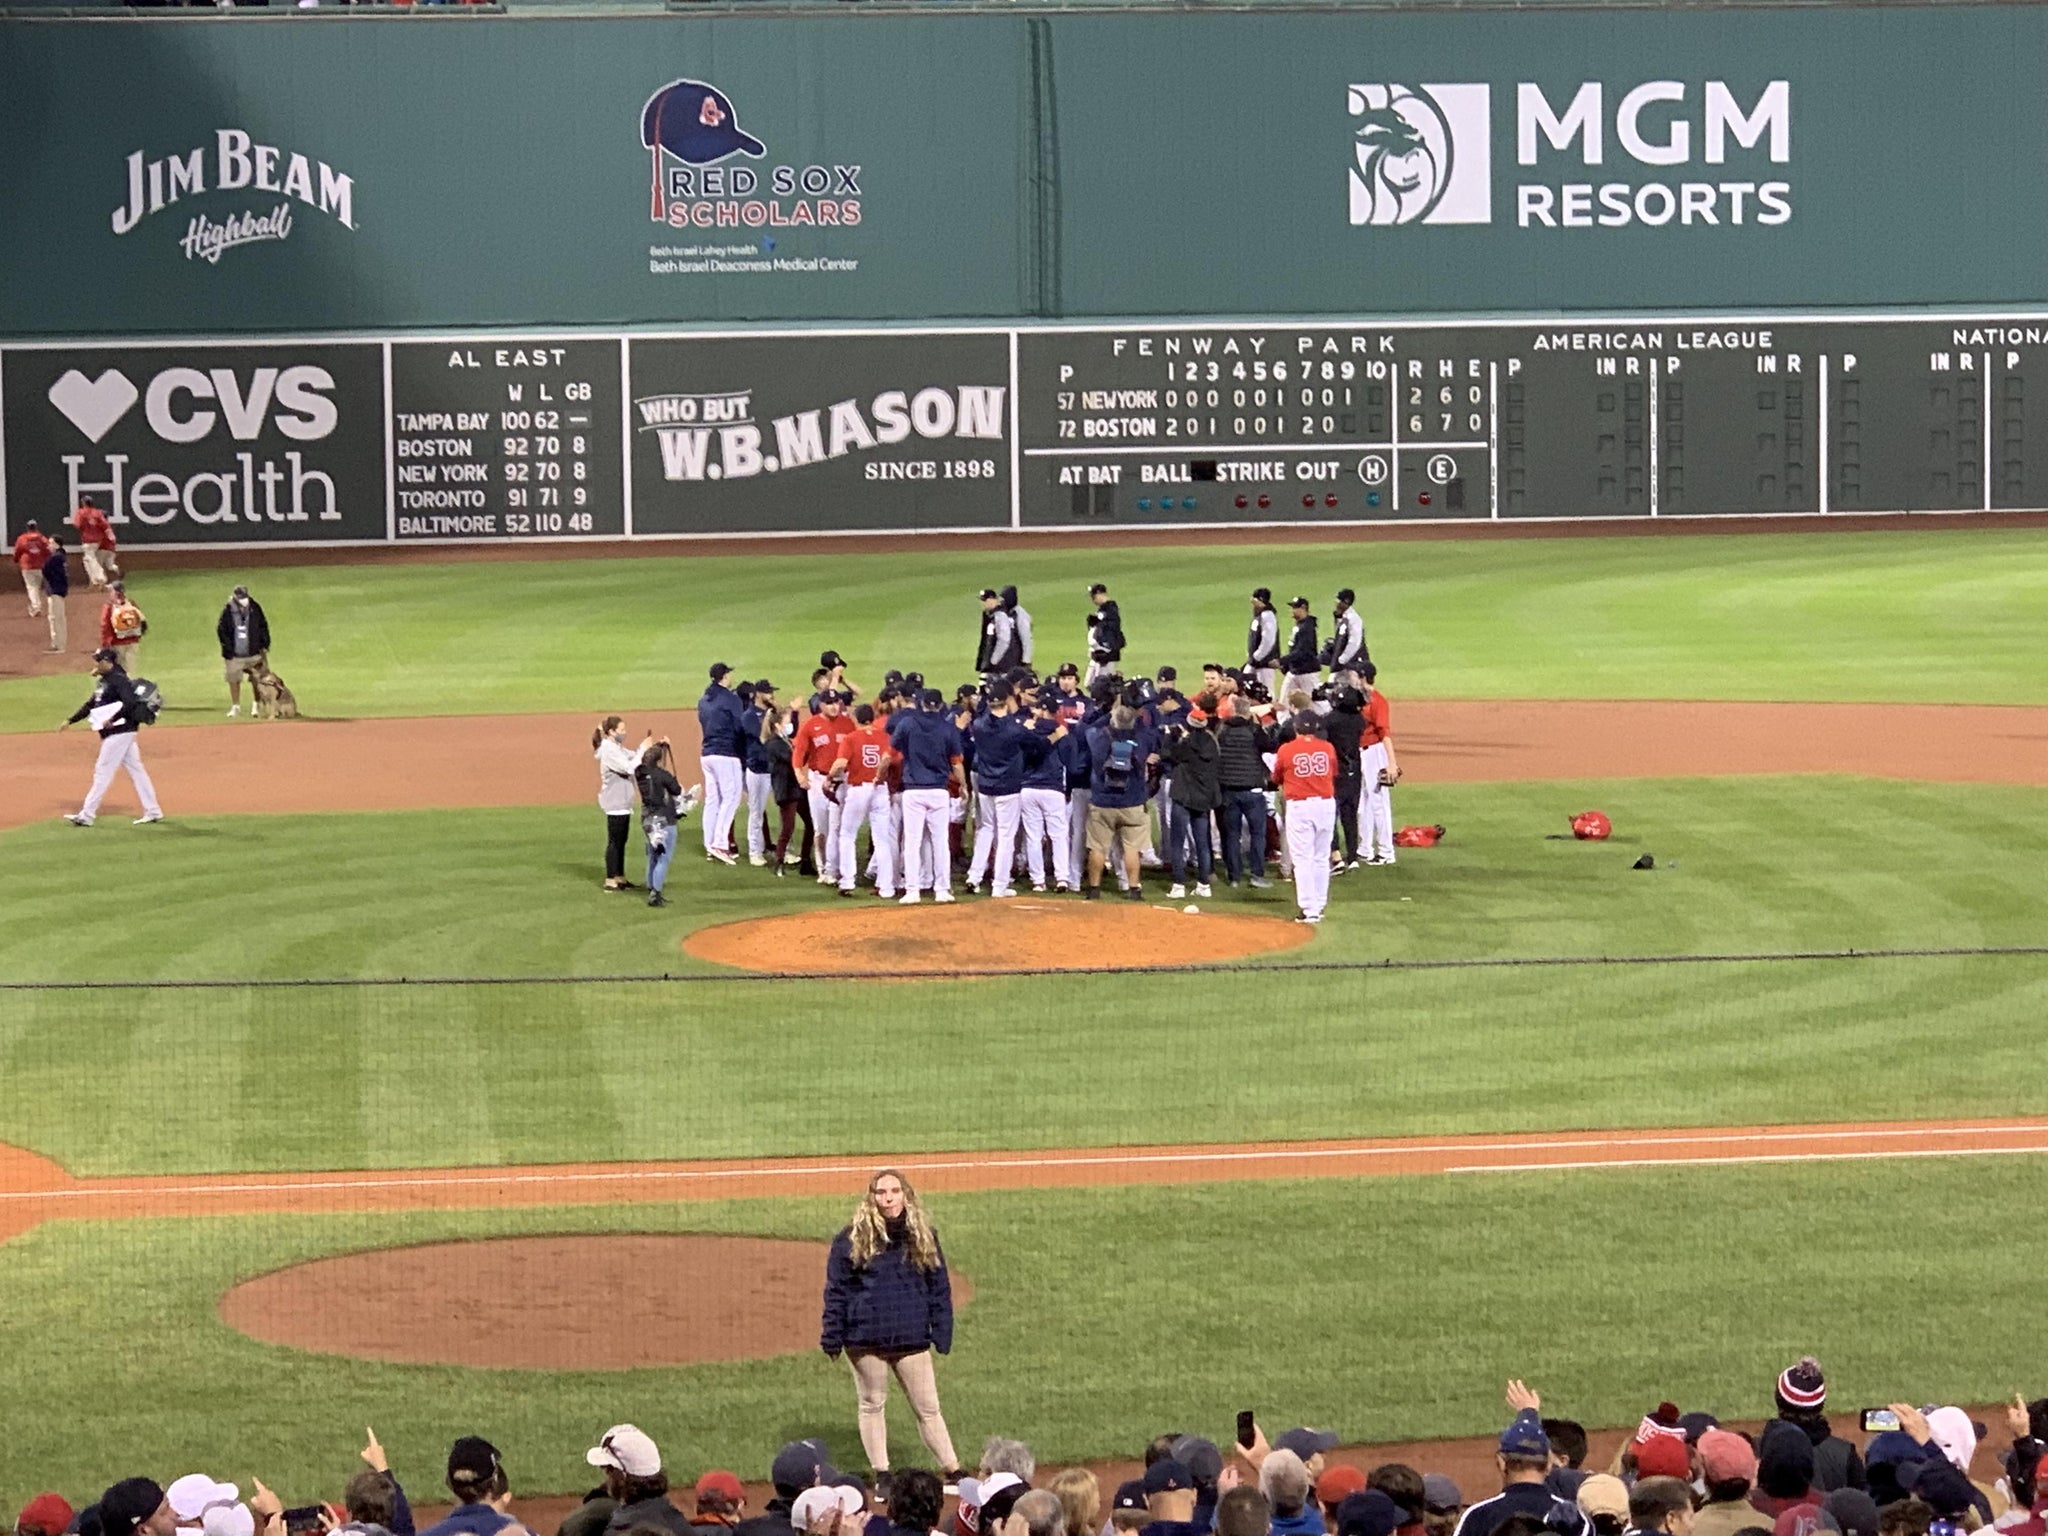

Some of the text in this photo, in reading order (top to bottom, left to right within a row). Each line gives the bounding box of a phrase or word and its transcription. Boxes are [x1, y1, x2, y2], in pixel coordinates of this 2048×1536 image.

[1517, 80, 1790, 165] MGM
[111, 129, 354, 235] JIM BEAM
[668, 165, 861, 198] RED SOX
[668, 200, 861, 228] SCHOLARS
[1517, 182, 1792, 227] RESORTS
[179, 202, 292, 264] Highball
[650, 246, 672, 256] Beth
[673, 246, 698, 256] Israel
[727, 244, 758, 256] Health
[650, 257, 858, 272] Beth Israel Deaconess Medical Center
[1114, 336, 1394, 356] FENWAY PARK
[1534, 332, 1772, 350] AMERICAN LEAGUE
[449, 350, 566, 367] AL EAST
[1408, 359, 1481, 378] R H E
[1508, 357, 1640, 376] P IN R
[1668, 354, 1801, 374] P IN R
[1844, 353, 1973, 372] P IN R
[2007, 352, 2020, 370] P
[1060, 365, 1074, 384] P
[1366, 360, 1386, 380] 10
[508, 383, 592, 401] W L GB
[1057, 392, 1075, 410] 57
[1410, 386, 1481, 404] 2 6 0
[145, 366, 338, 442] CVS
[639, 396, 750, 425] WHO BUT
[397, 413, 453, 431] TAMPA
[457, 413, 489, 430] BAY
[502, 412, 530, 429] 100
[534, 411, 559, 429] 62
[1058, 420, 1076, 438] 72
[1083, 418, 1156, 438] BOSTON
[1410, 414, 1482, 432] 6 7 0
[398, 436, 586, 456] BOSTON 92 70 8
[399, 462, 586, 482] NEW YORK 92 70 8
[864, 460, 995, 480] SINCE 1898
[1058, 462, 1340, 485] AT BAT BALL STRIKE OUT
[62, 452, 342, 525] Health
[399, 487, 586, 508] TORONTO 91 71 9
[399, 512, 592, 534] BALTIMORE 52 110 48
[862, 744, 880, 768] 5
[1292, 752, 1330, 778] 33
